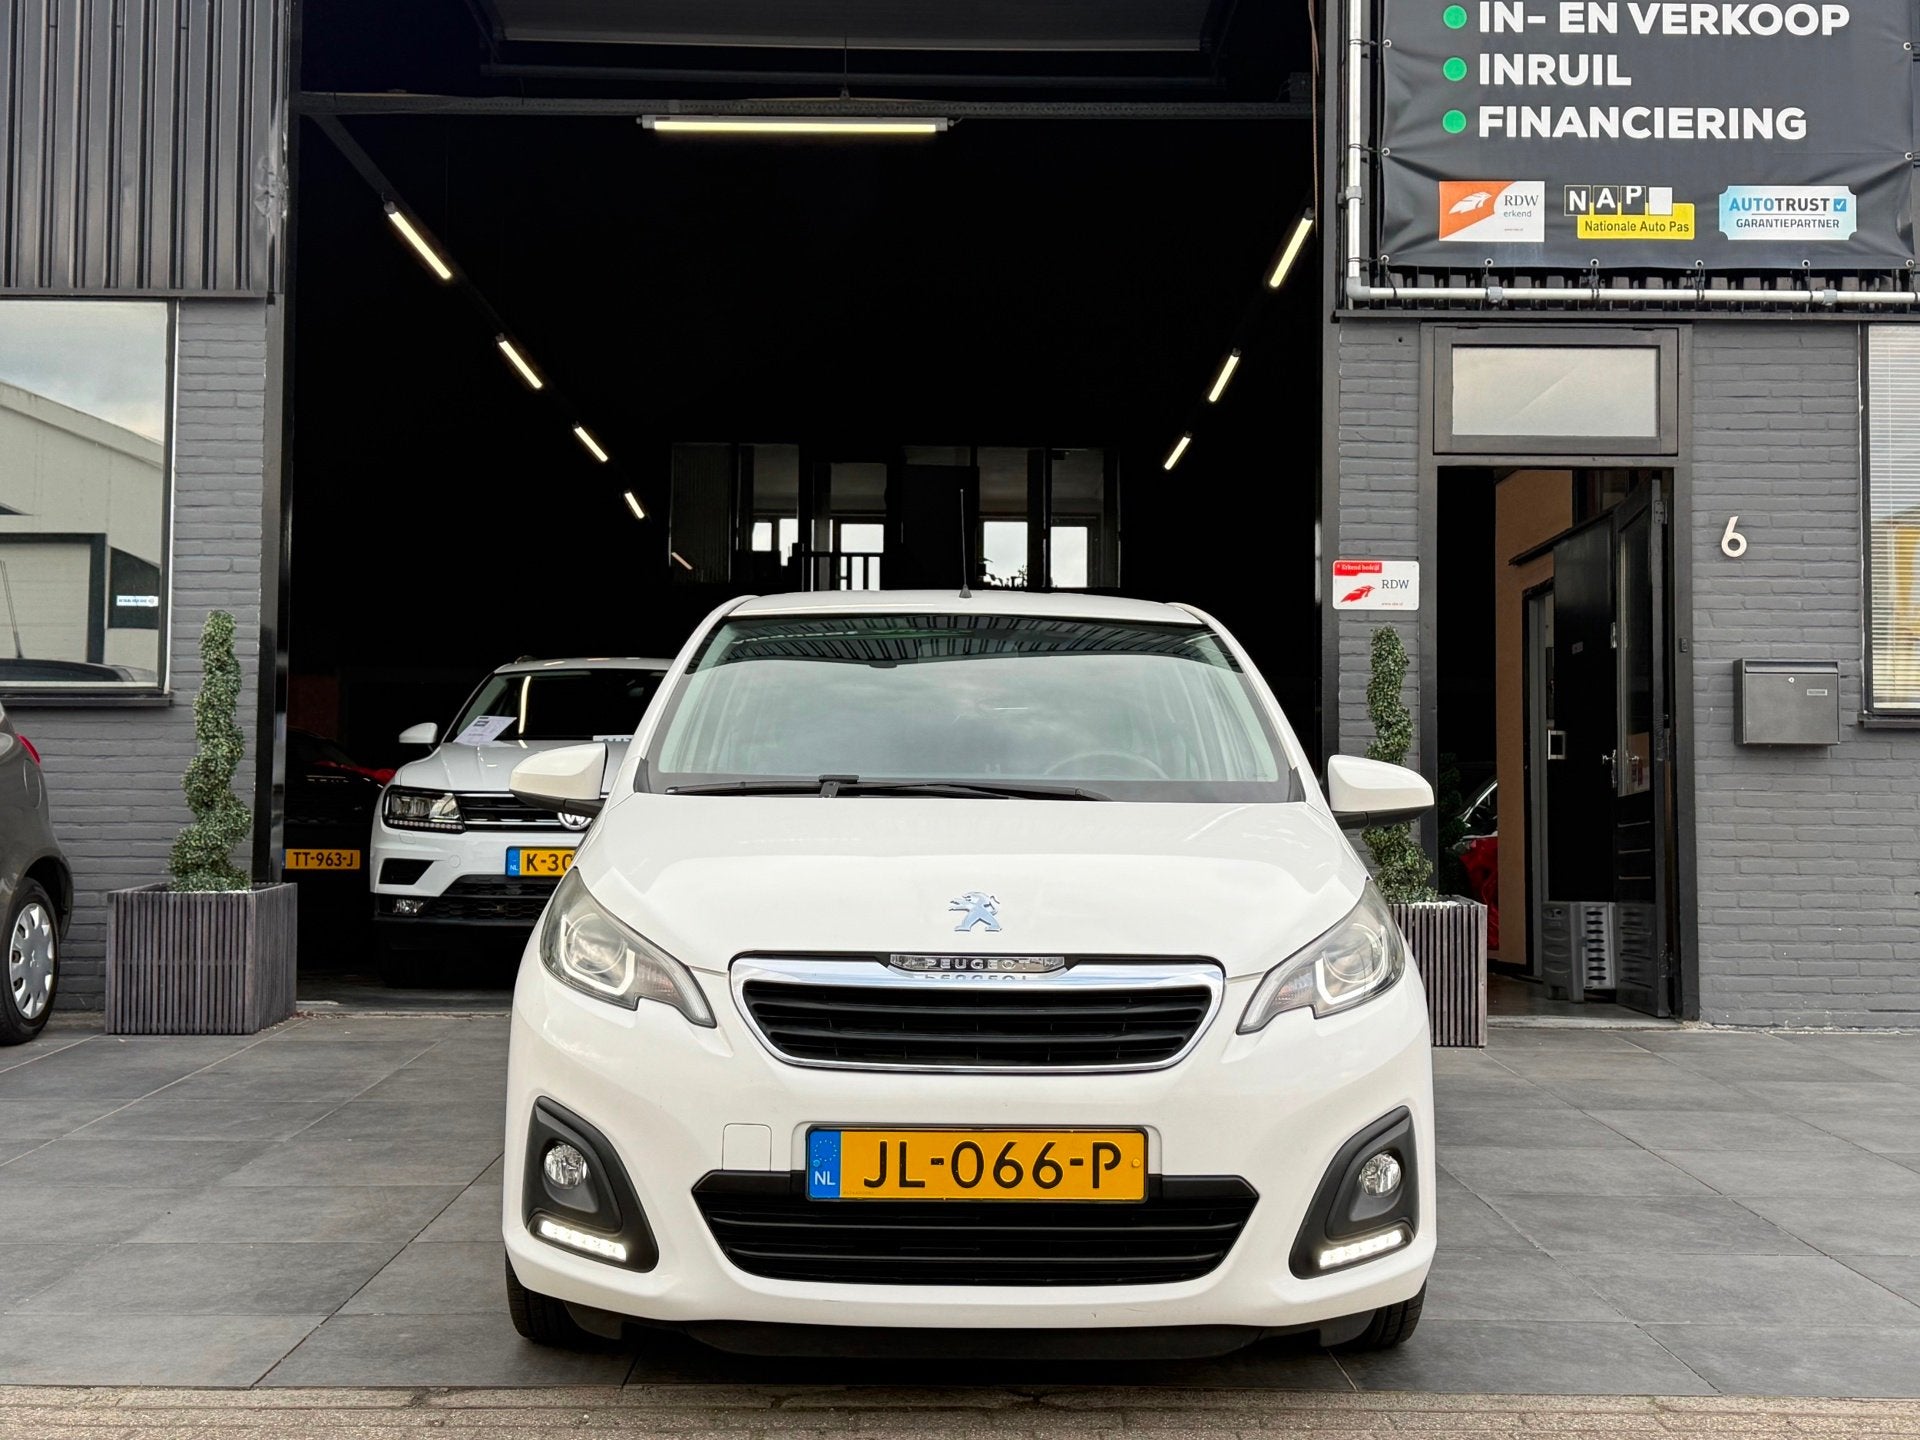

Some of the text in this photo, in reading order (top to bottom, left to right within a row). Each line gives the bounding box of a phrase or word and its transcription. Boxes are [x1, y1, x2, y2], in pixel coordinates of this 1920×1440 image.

[1479, 1, 1850, 36] IN- EN VERKOOP
[1479, 53, 1632, 86] INRUIL
[1479, 105, 1807, 140] FINANCIERING
[1504, 194, 1539, 207] RDW
[1729, 197, 1830, 212] AUTOTRUST
[1503, 210, 1532, 218] erkend
[1585, 220, 1690, 232] Nationale Auto Pas
[1736, 218, 1840, 228] GARANTIEPARTNER
[1721, 515, 1748, 558] 6
[1381, 579, 1410, 590] RDW
[292, 851, 354, 867] TT-963-J
[925, 957, 1031, 970] PEUGEOT
[814, 1140, 1122, 1189] NL JL-066-P
